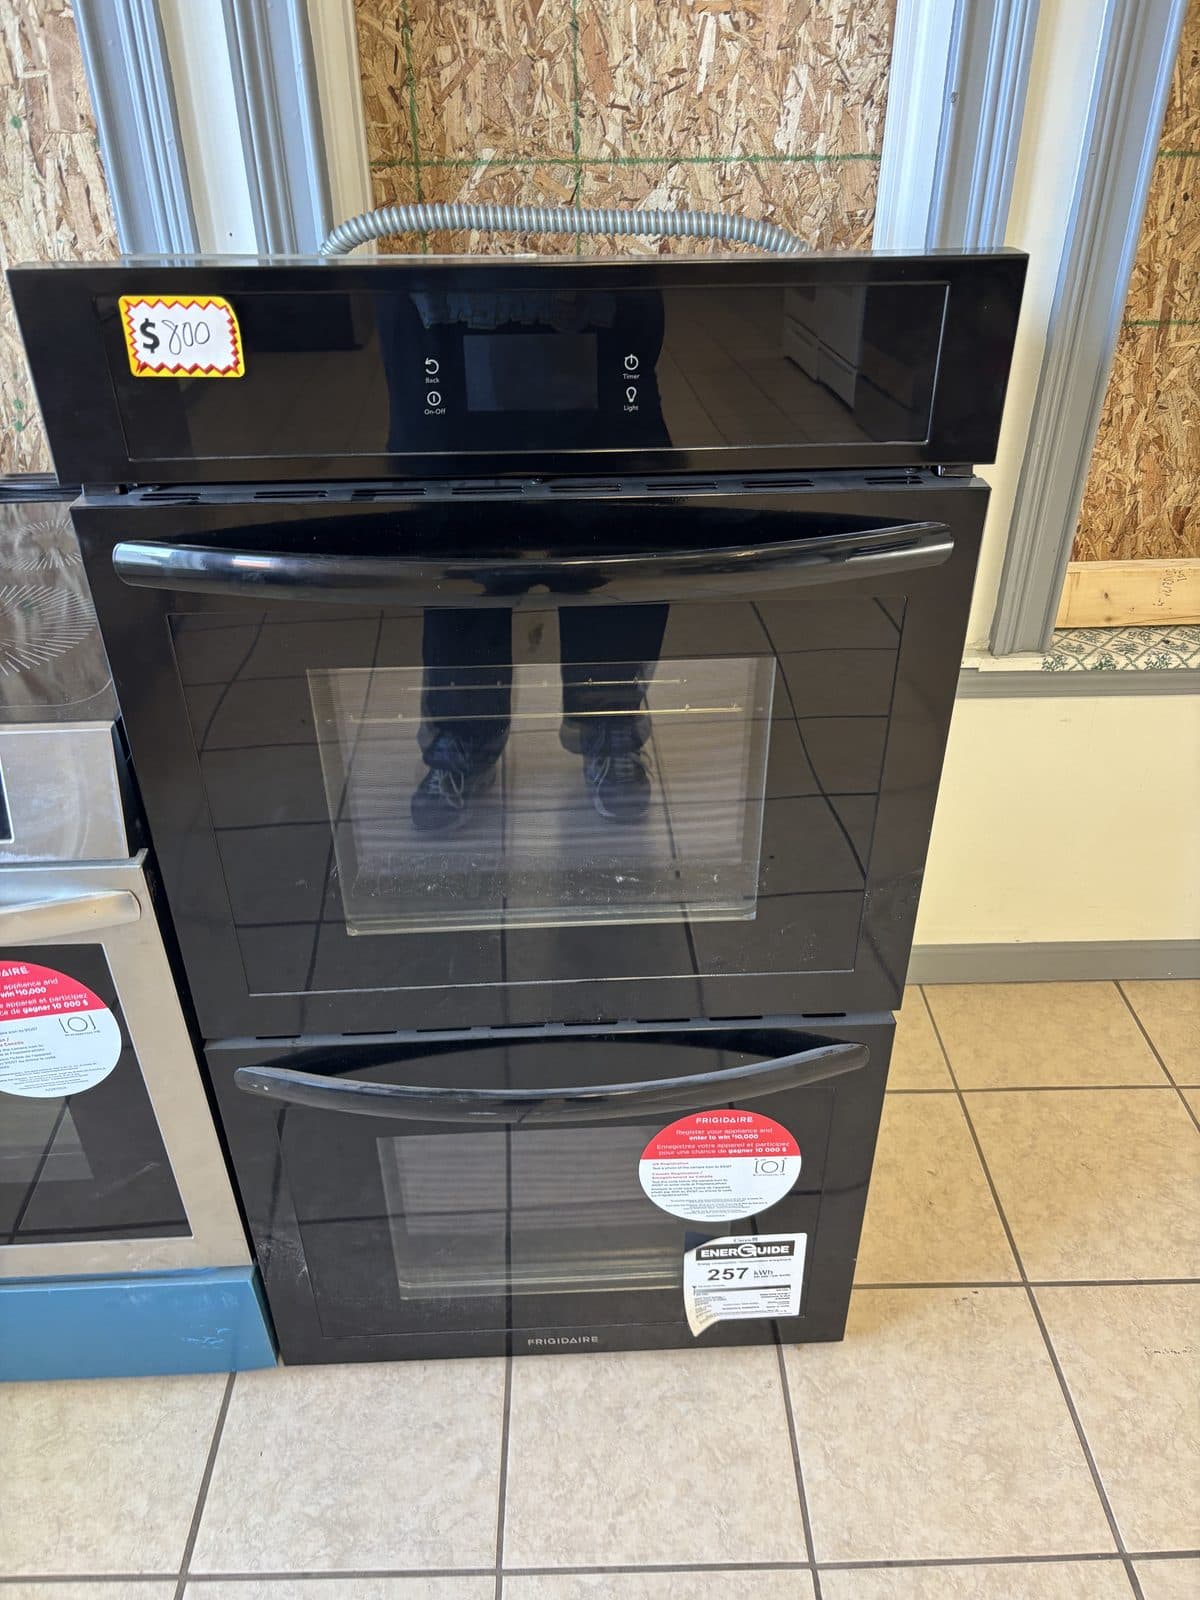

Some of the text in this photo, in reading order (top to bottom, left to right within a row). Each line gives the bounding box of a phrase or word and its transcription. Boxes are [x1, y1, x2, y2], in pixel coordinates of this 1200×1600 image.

[623, 404, 639, 412] Light
[0, 966, 29, 977] AIRE
[43, 977, 58, 986] and
[22, 1004, 51, 1014] gagner
[52, 1002, 62, 1010] 10
[64, 1000, 81, 1008] 000
[696, 1116, 753, 1124] FRIGIDAIRE
[717, 1142, 748, 1150] appareil
[700, 1243, 790, 1258] ENERGUIDE
[707, 1267, 749, 1281] 257
[527, 1336, 599, 1346] FRIGIDAIRE
